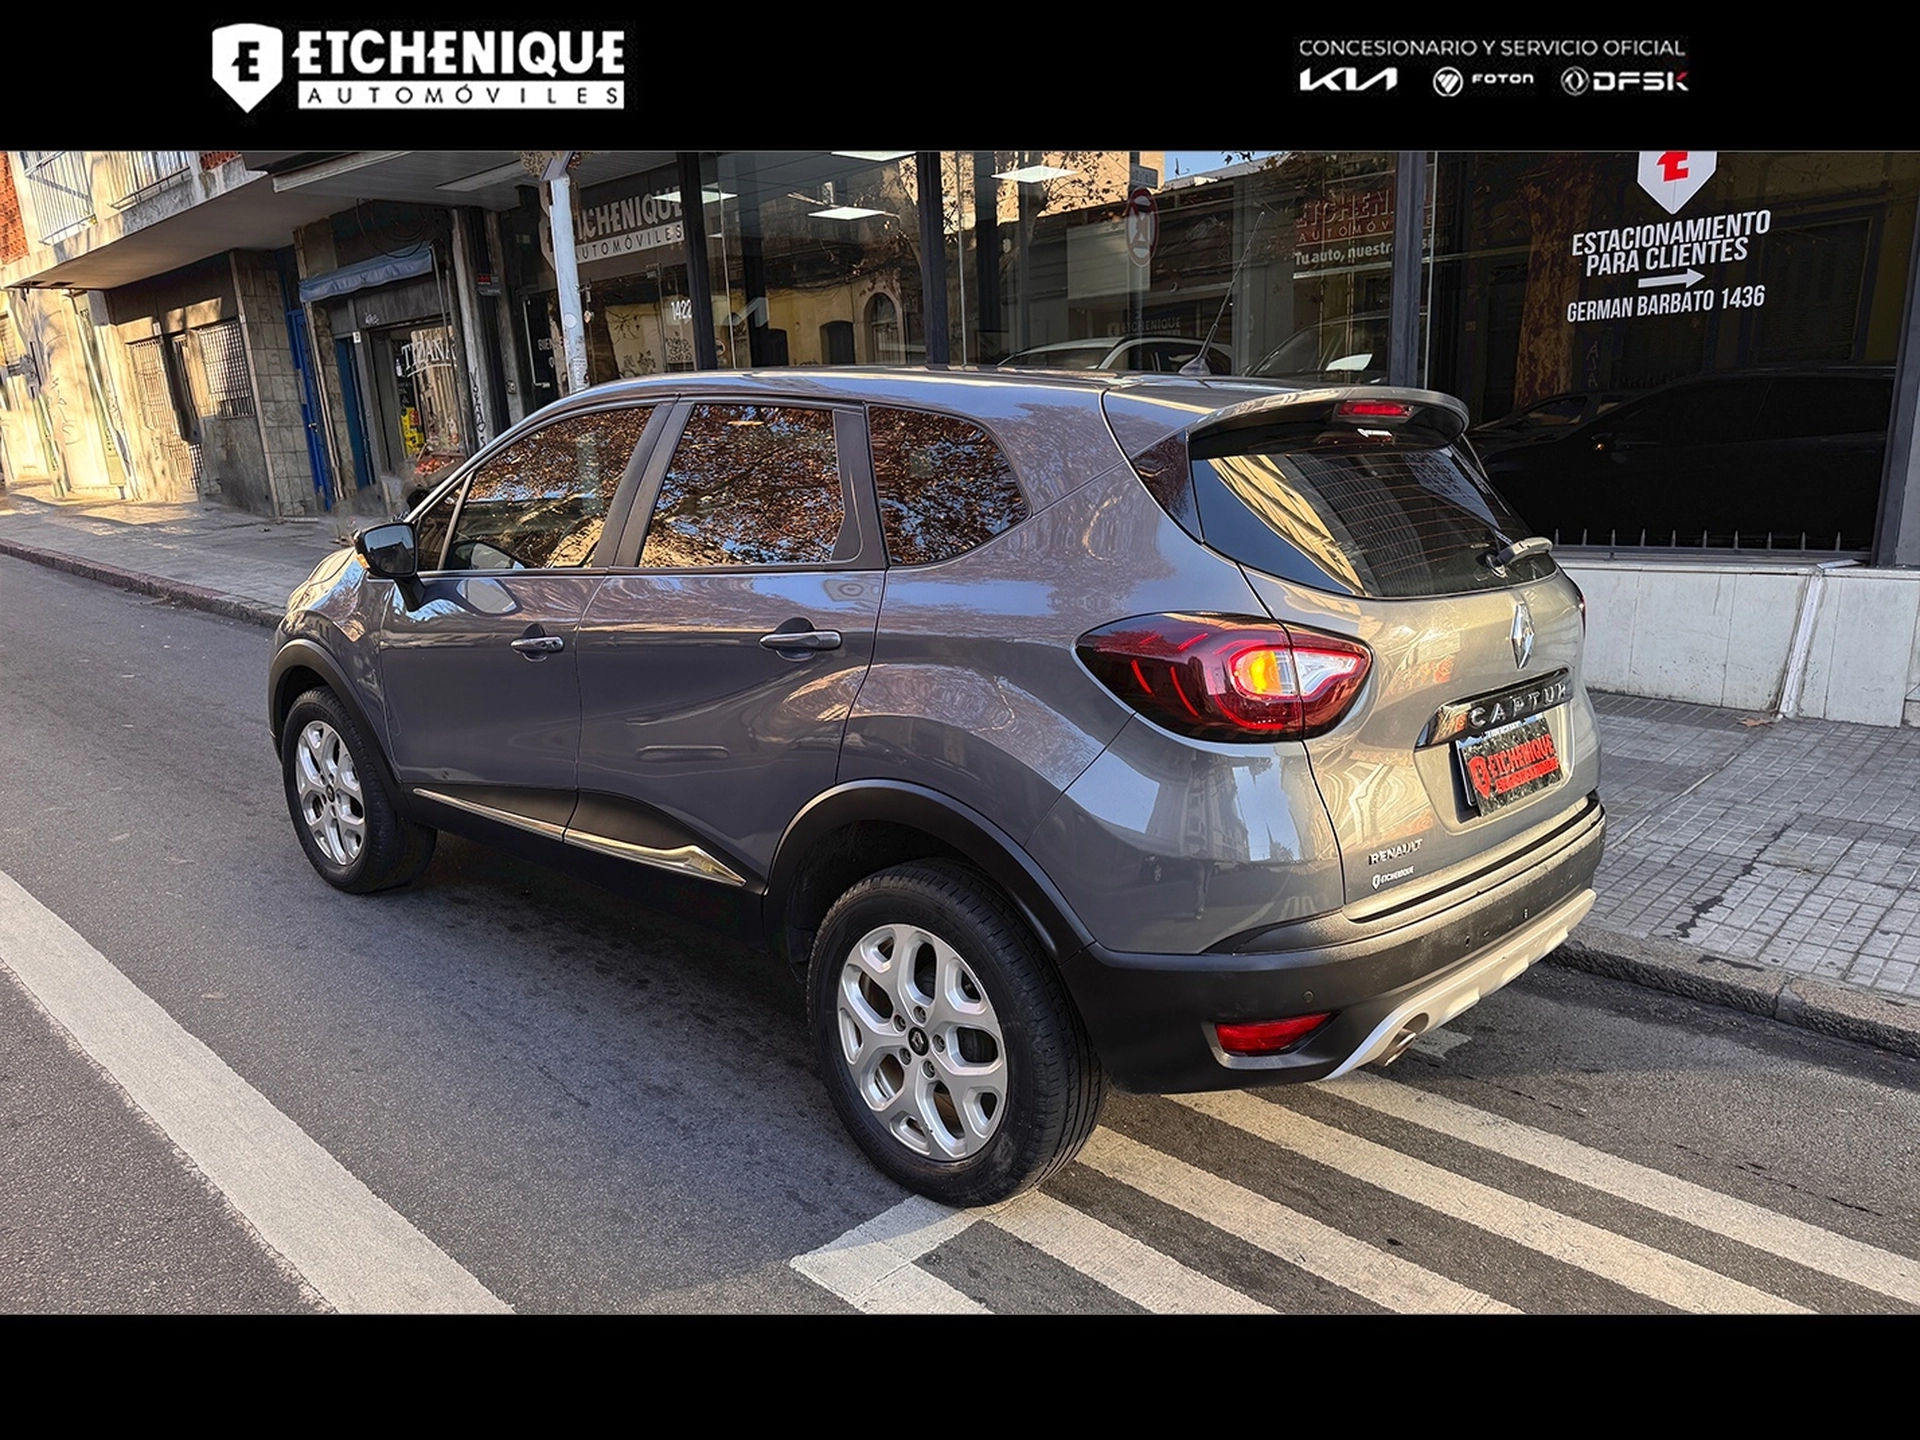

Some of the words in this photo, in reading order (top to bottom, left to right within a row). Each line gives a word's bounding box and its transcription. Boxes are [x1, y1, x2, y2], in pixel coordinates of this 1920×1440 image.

[577, 224, 682, 260] UTOMÓVILES
[1347, 241, 1394, 259] nuestr
[1572, 209, 1771, 256] ESTACIONAMIENTO
[1586, 250, 1640, 277] PARA
[1645, 237, 1749, 270] CLIENTES
[671, 299, 692, 320] 1422
[1567, 297, 1633, 322] GERMAN
[1637, 289, 1714, 316] BARBATO
[1722, 284, 1766, 309] 1436
[1469, 682, 1566, 729] CAPTUR
[1368, 838, 1423, 866] RENAULT
